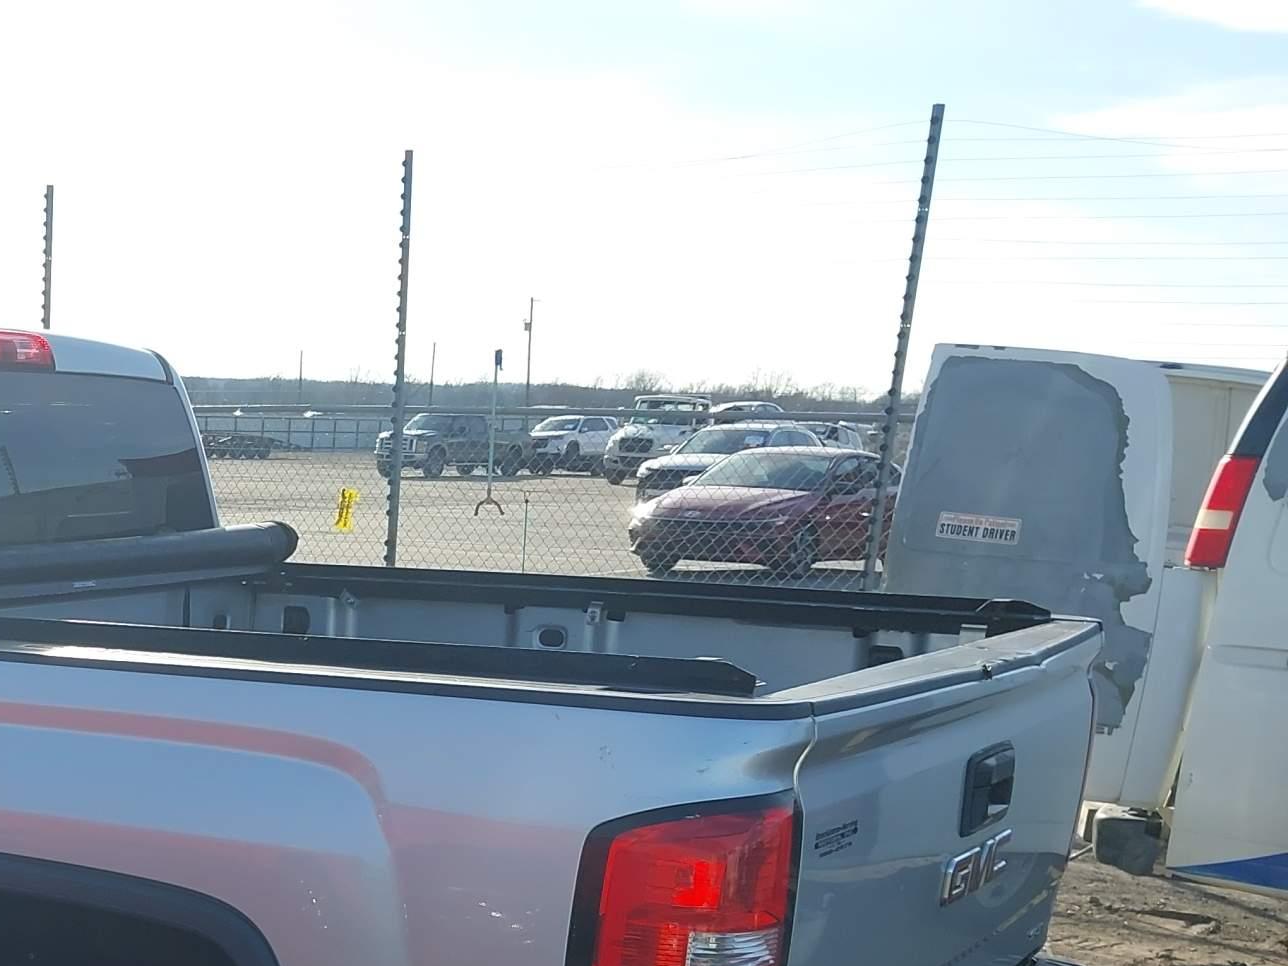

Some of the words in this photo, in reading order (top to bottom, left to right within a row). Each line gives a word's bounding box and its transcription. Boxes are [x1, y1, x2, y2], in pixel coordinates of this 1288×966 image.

[939, 523, 980, 537] STUDENT
[982, 527, 1016, 541] DRIVER
[940, 829, 1012, 906] GMC
